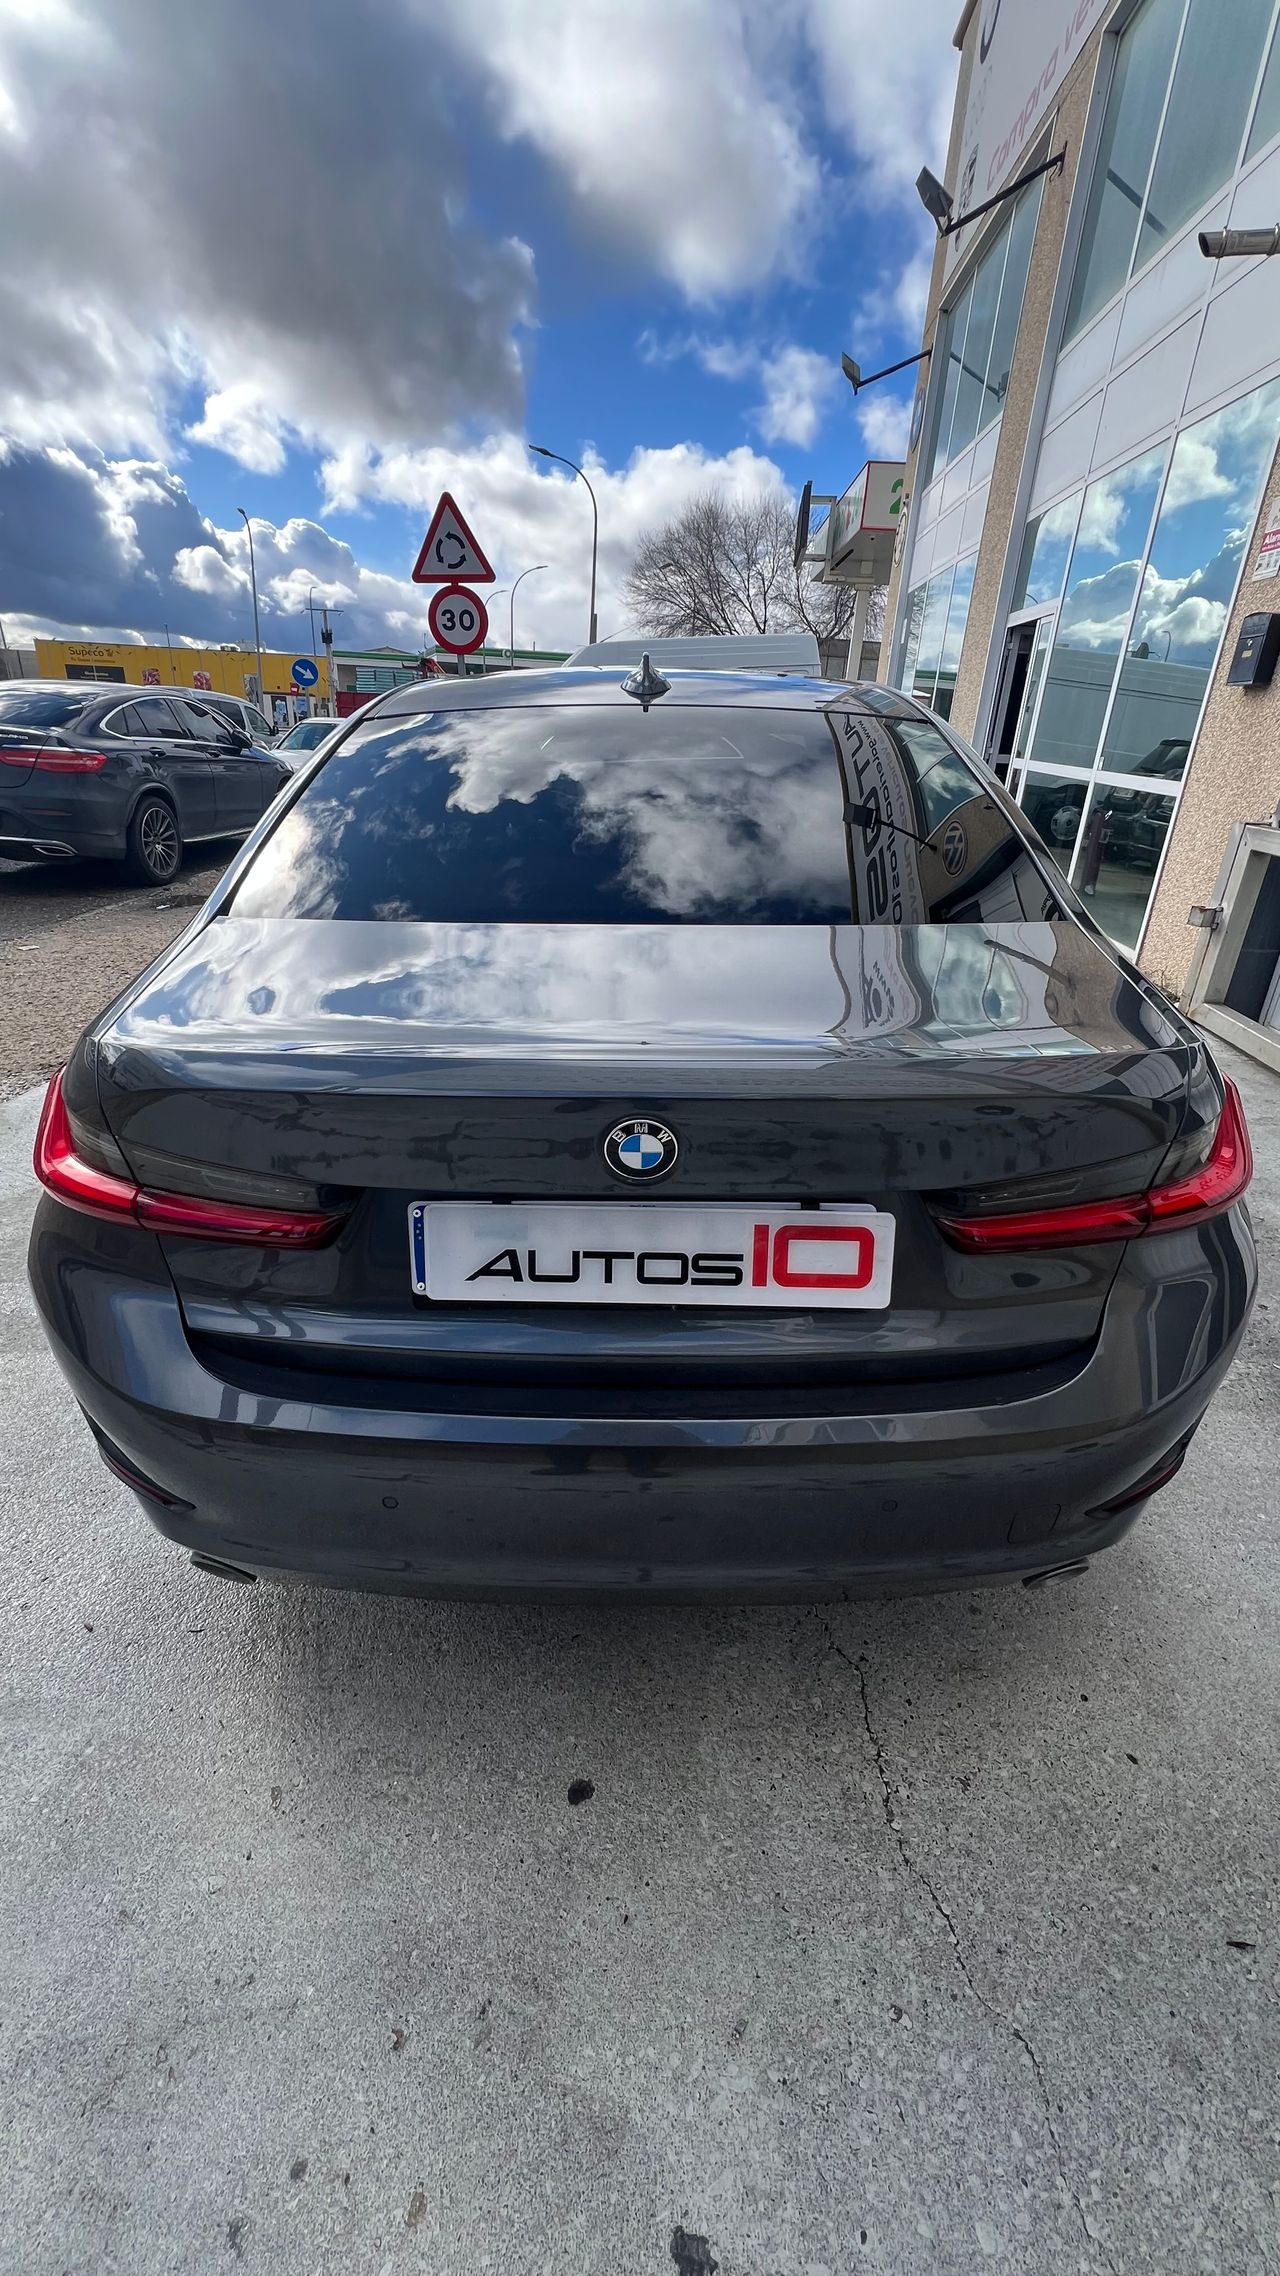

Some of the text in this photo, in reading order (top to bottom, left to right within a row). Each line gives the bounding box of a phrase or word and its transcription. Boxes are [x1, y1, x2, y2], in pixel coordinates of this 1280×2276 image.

[1064, 0, 1095, 55] ve
[440, 608, 476, 633] 30
[612, 1123, 672, 1143] BMW
